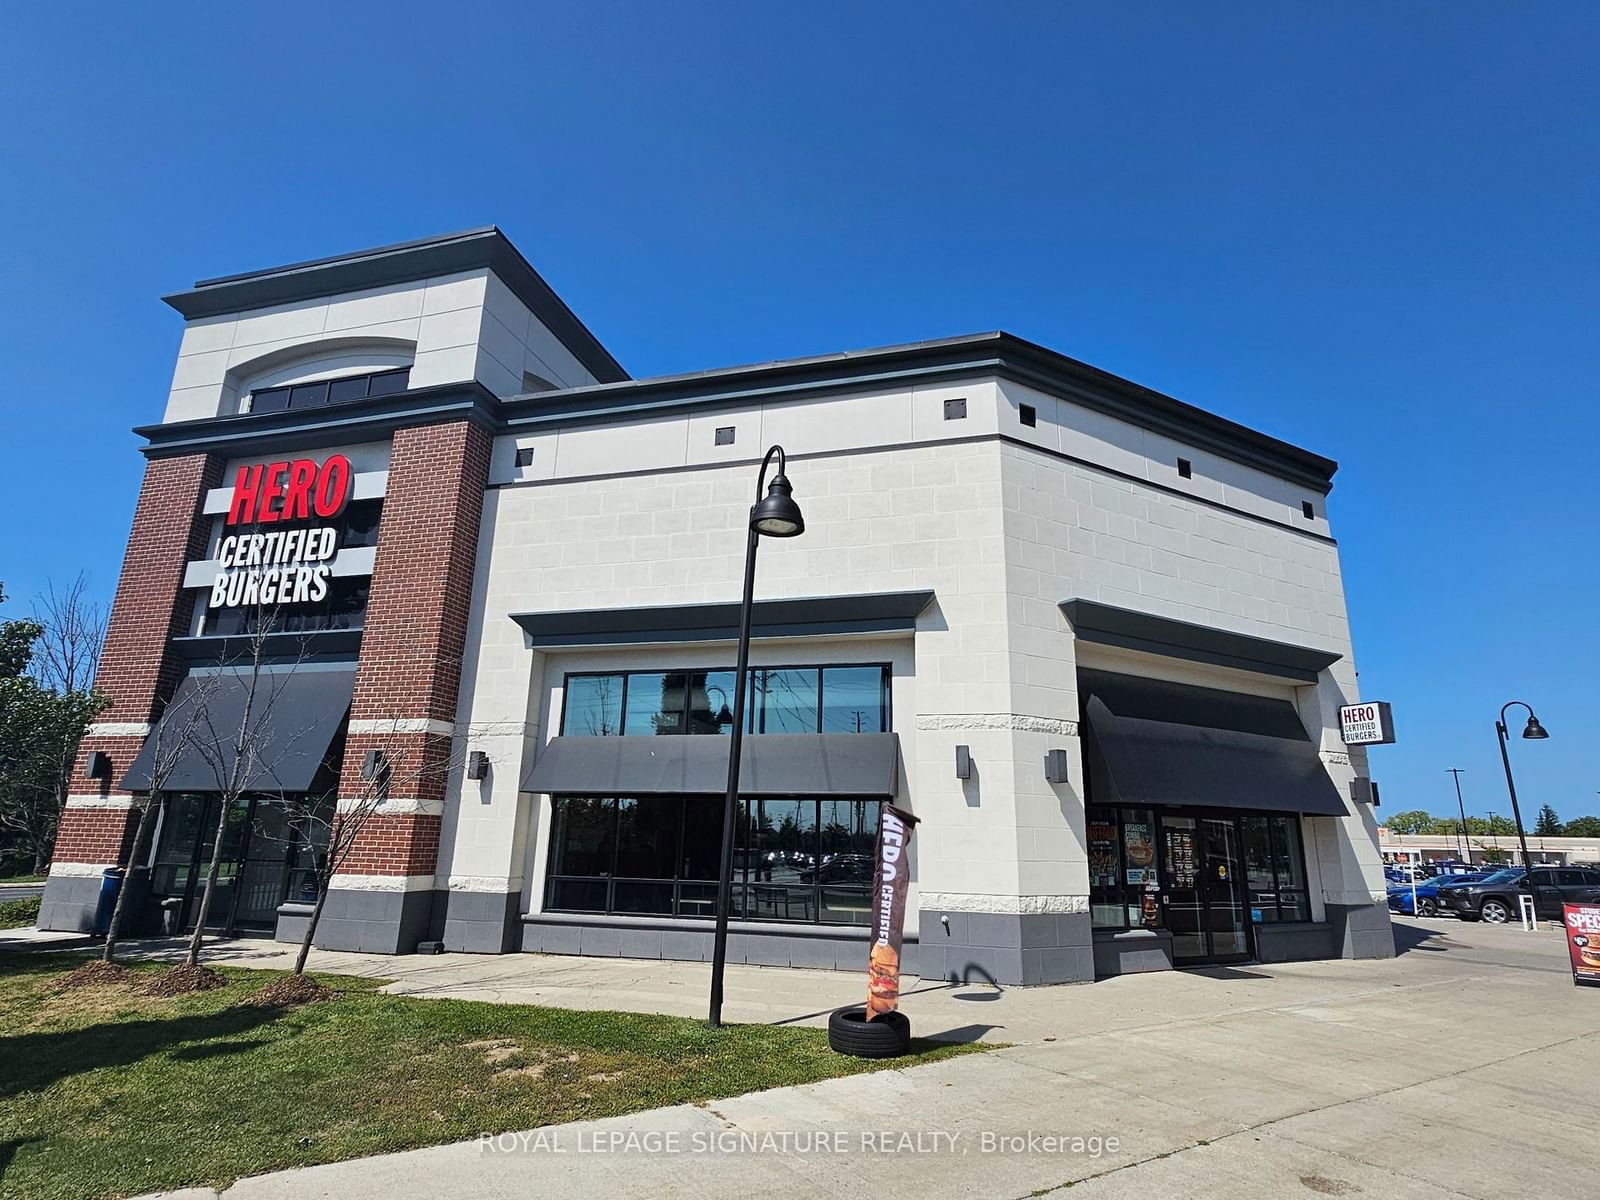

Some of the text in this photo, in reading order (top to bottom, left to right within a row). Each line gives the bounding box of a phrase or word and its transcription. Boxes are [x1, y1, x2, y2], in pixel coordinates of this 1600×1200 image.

[226, 454, 352, 526] HERO
[219, 528, 337, 569] CERTIFIED
[209, 566, 329, 608] BURGERS
[1344, 706, 1374, 723] HERO
[1345, 722, 1376, 732] CERTIFIED
[1346, 731, 1377, 741] BURGERS
